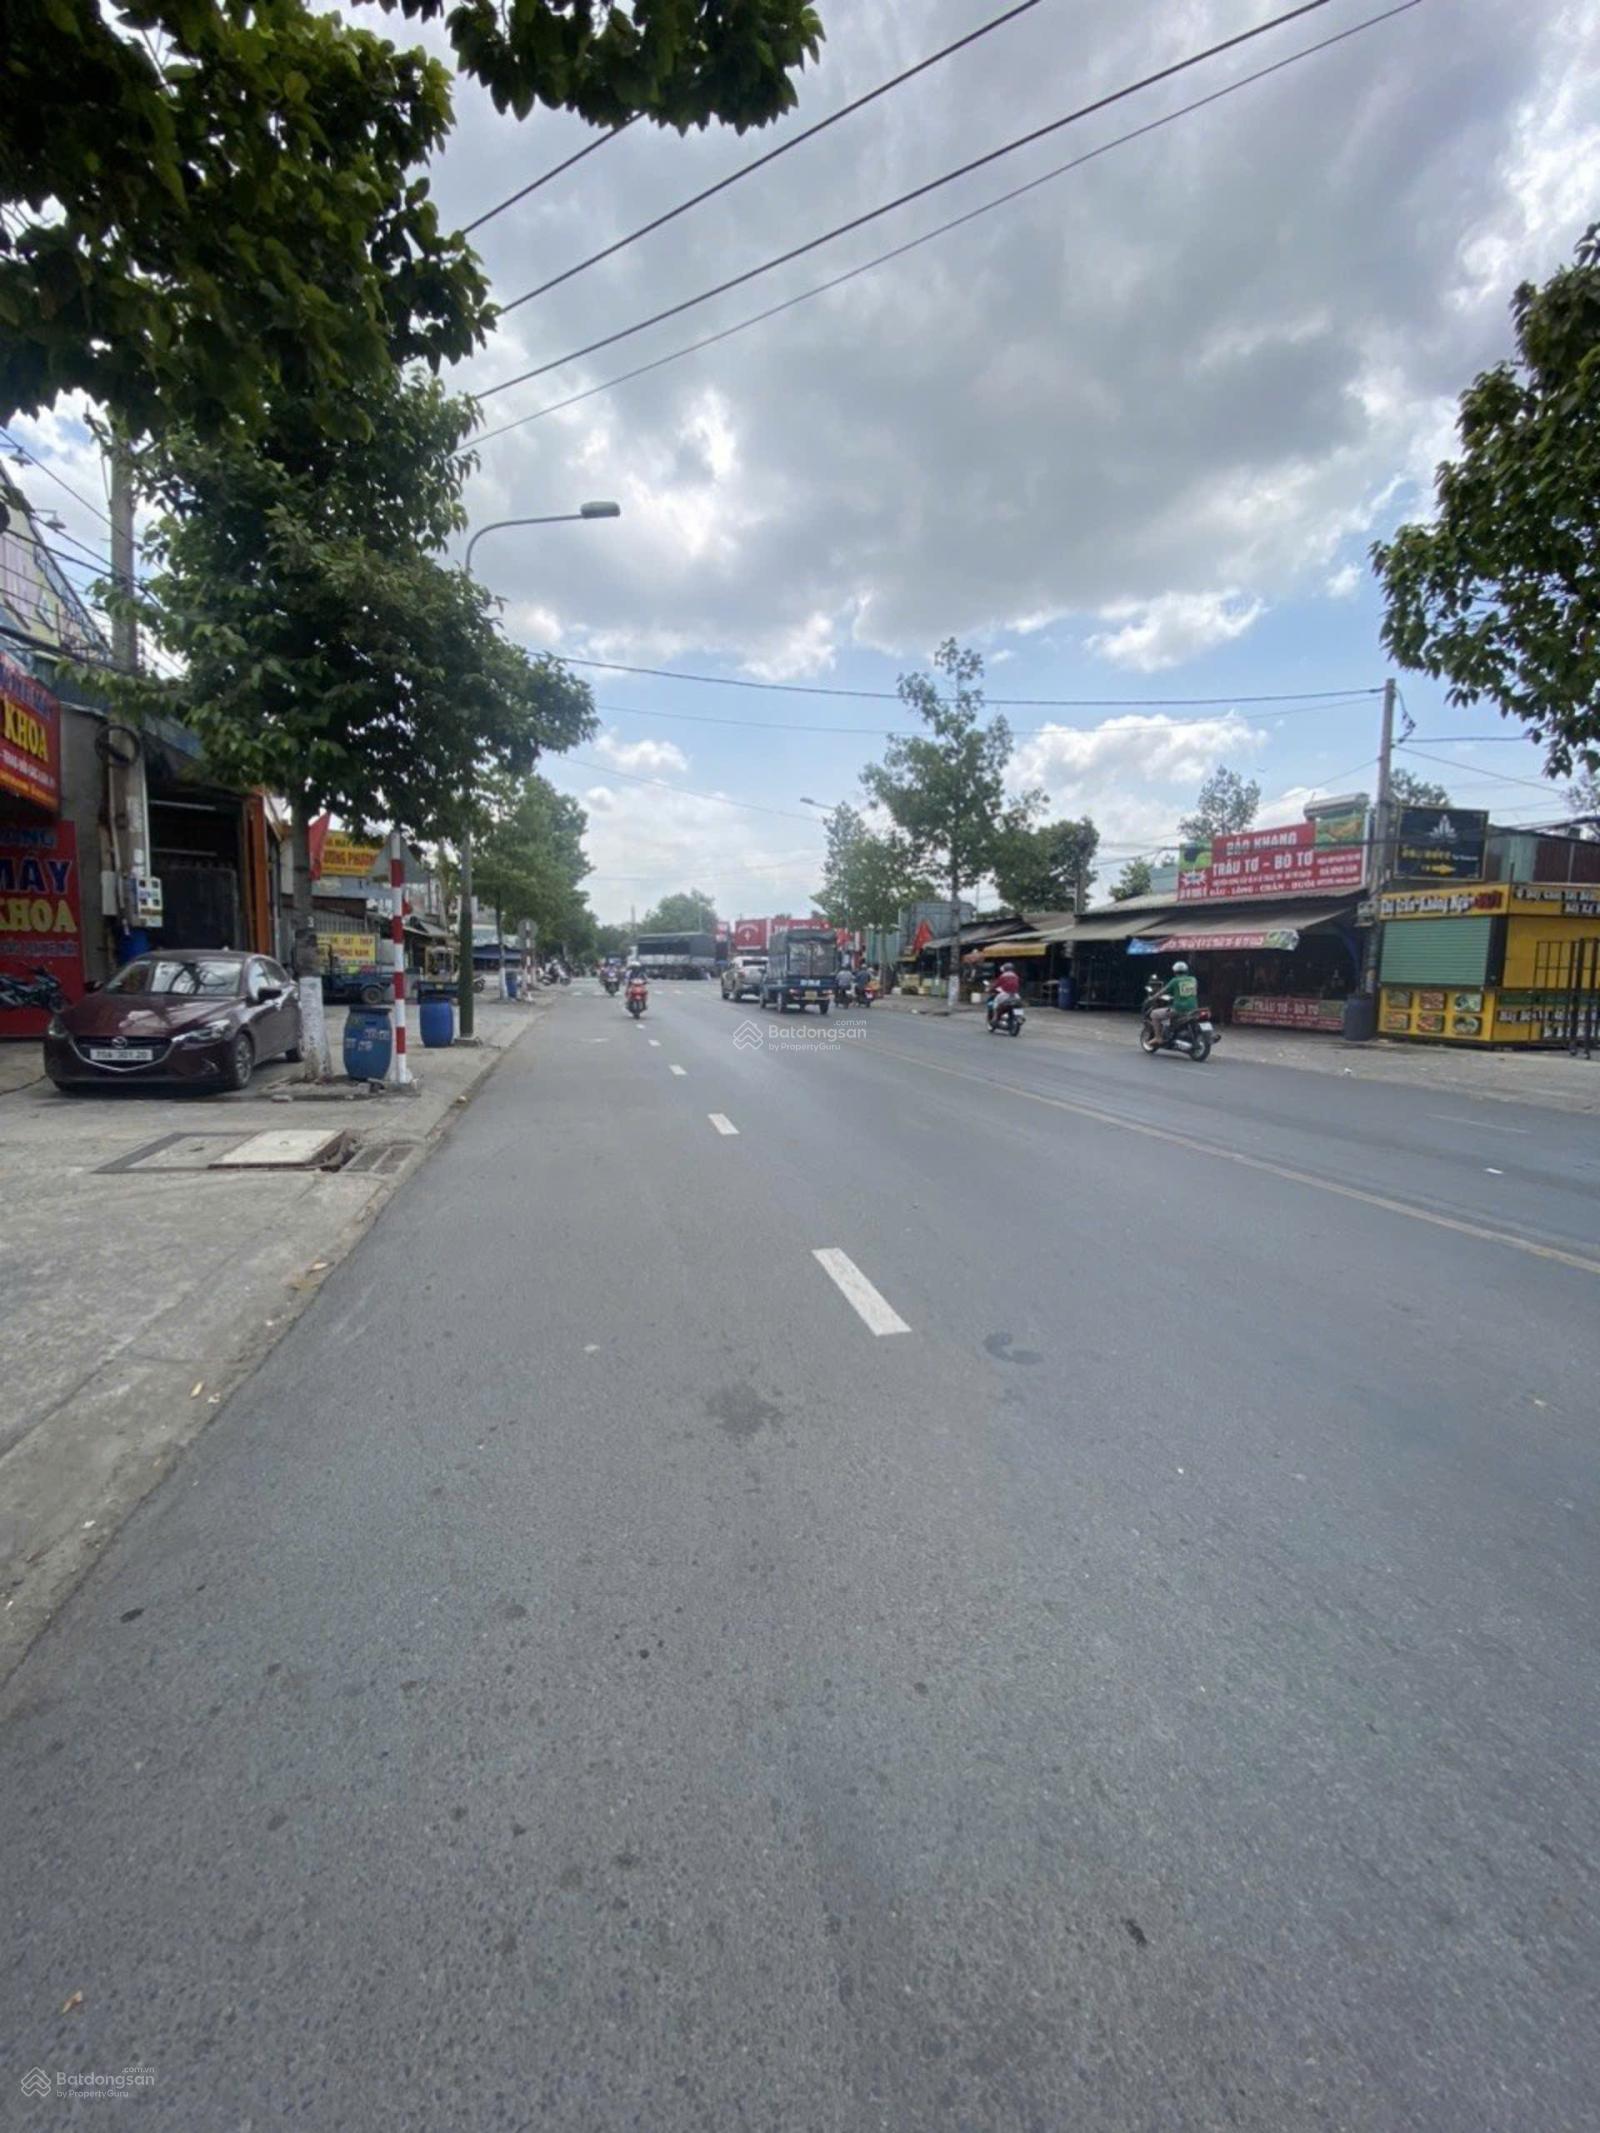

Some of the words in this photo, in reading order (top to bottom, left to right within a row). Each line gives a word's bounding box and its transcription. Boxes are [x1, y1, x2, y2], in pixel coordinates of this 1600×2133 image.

[4, 699, 49, 762] KHOA
[1213, 859, 1240, 877] TRÂU
[1245, 856, 1259, 873] TƠ
[1274, 851, 1292, 870] BÒ
[1296, 849, 1314, 867] TƠ
